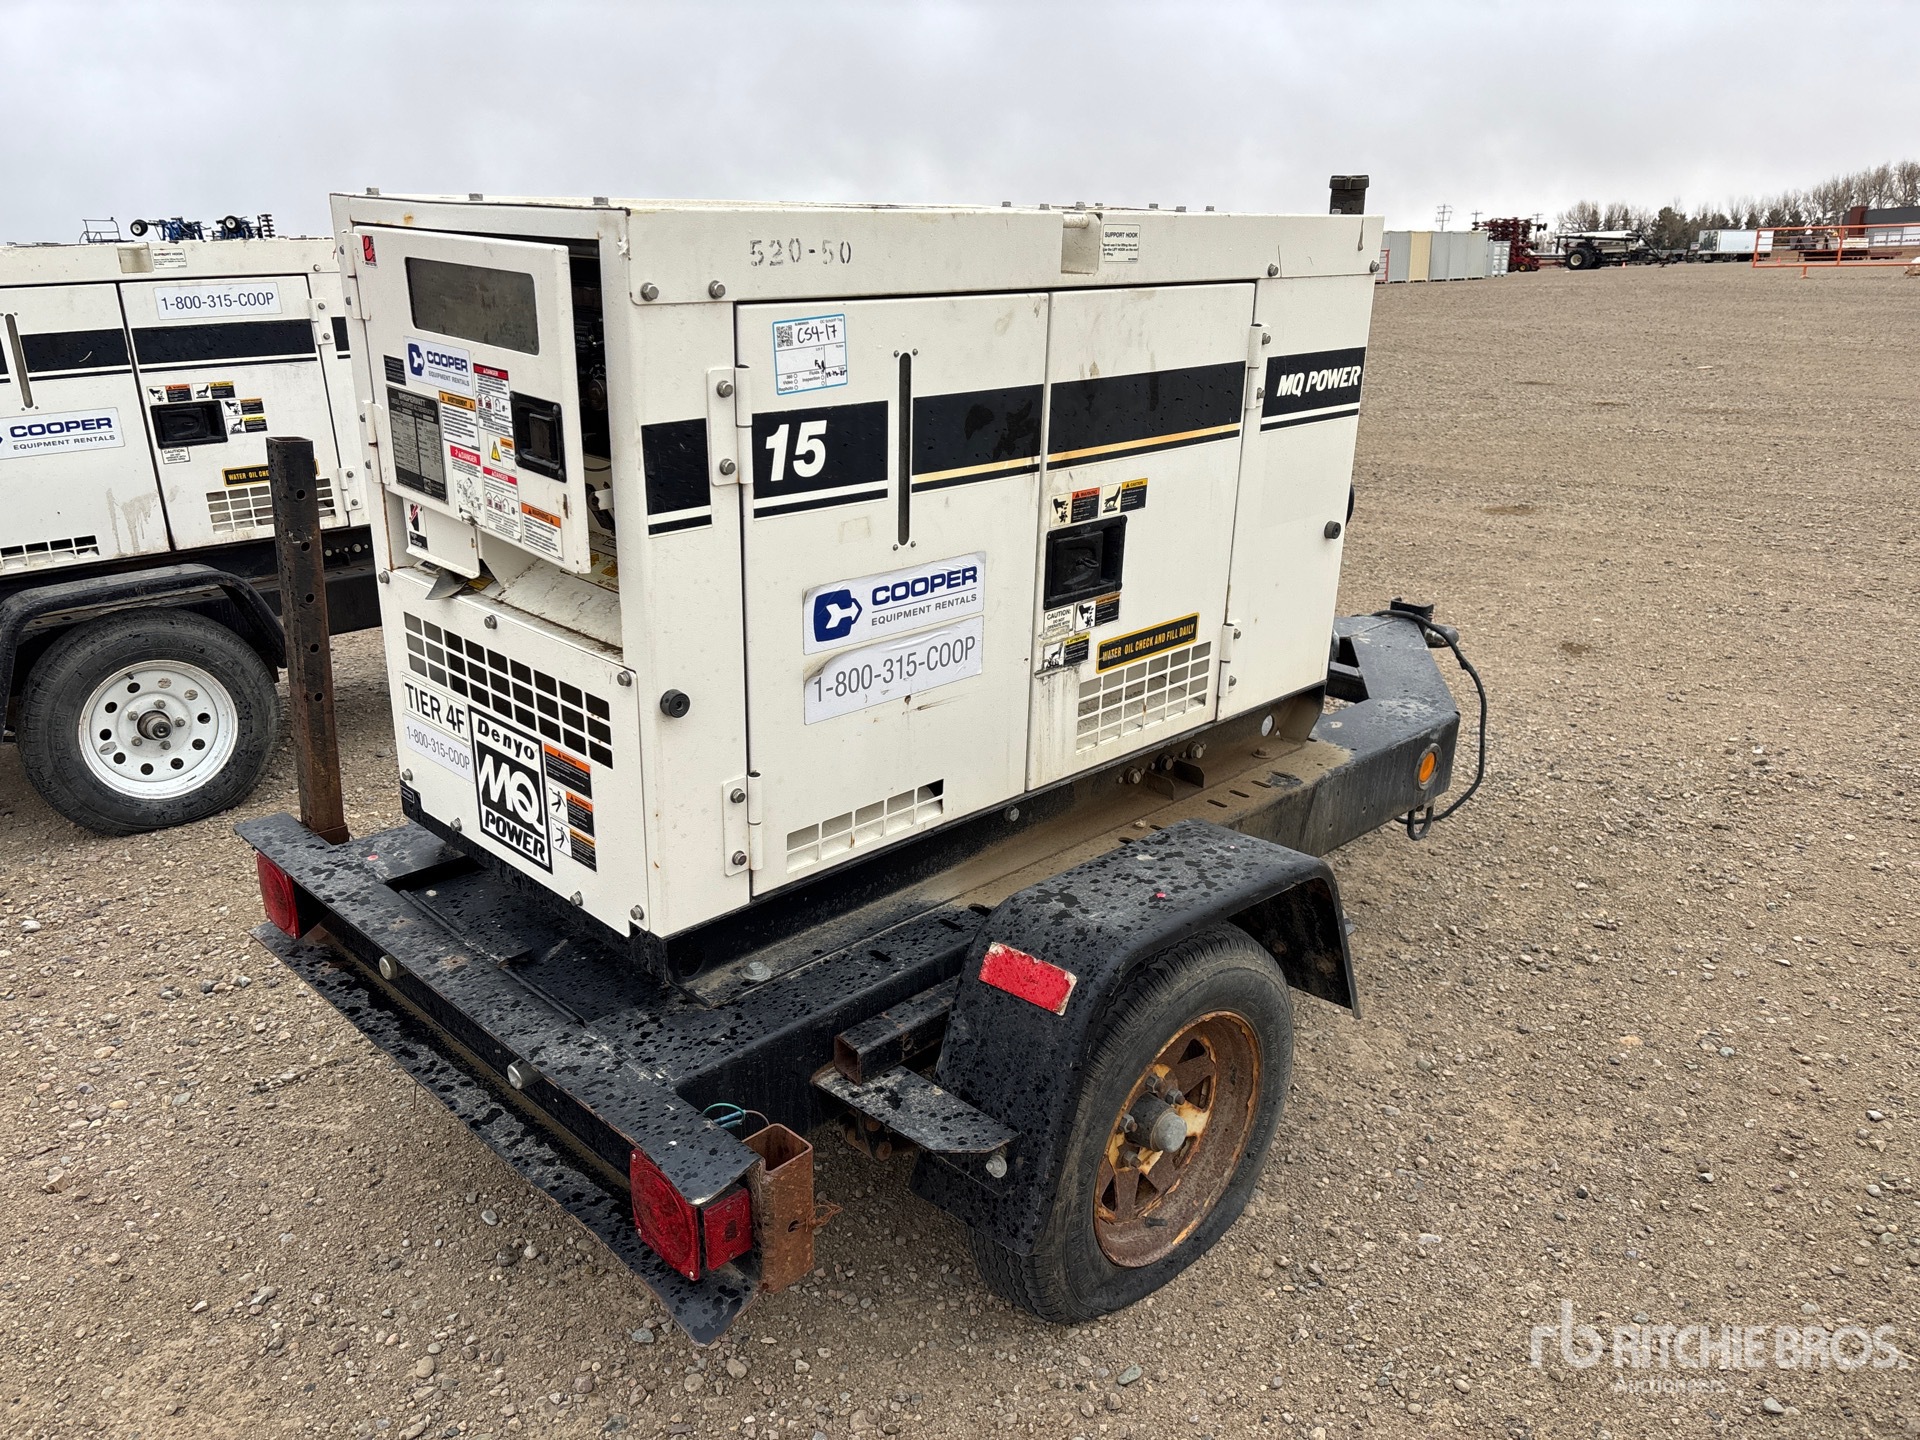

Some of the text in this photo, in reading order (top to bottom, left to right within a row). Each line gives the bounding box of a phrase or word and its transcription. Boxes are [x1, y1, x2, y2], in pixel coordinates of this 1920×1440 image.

[750, 238, 851, 266] 520-50
[161, 292, 274, 310] 1-800-315-COOP
[427, 350, 468, 373] COOPER
[428, 370, 451, 382] EQUIPMENT
[452, 376, 470, 386] RENTALS
[1276, 366, 1361, 397] MQ POWER
[9, 417, 113, 438] COOPER
[13, 434, 116, 450] EQUIPMENT RENTALS
[765, 420, 828, 482] 15
[228, 472, 246, 480] WATER
[872, 566, 978, 606] COOPER
[871, 593, 977, 626] EQUIPMENT RENTALS
[1046, 609, 1072, 620] CAUTION:
[1102, 646, 1122, 662] WATER
[1124, 644, 1134, 654] OIL
[1135, 636, 1154, 652] CHECK
[1154, 632, 1166, 645] AND
[1166, 628, 1178, 641] FILL
[1179, 624, 1195, 637] DAILY
[814, 636, 976, 702] 1-800-315-COOP
[404, 682, 464, 734] TIER 4F
[406, 726, 470, 770] 1-800-315-COOP
[478, 718, 535, 760] Denyo
[479, 753, 545, 836] MQ
[485, 809, 546, 862] POWER
